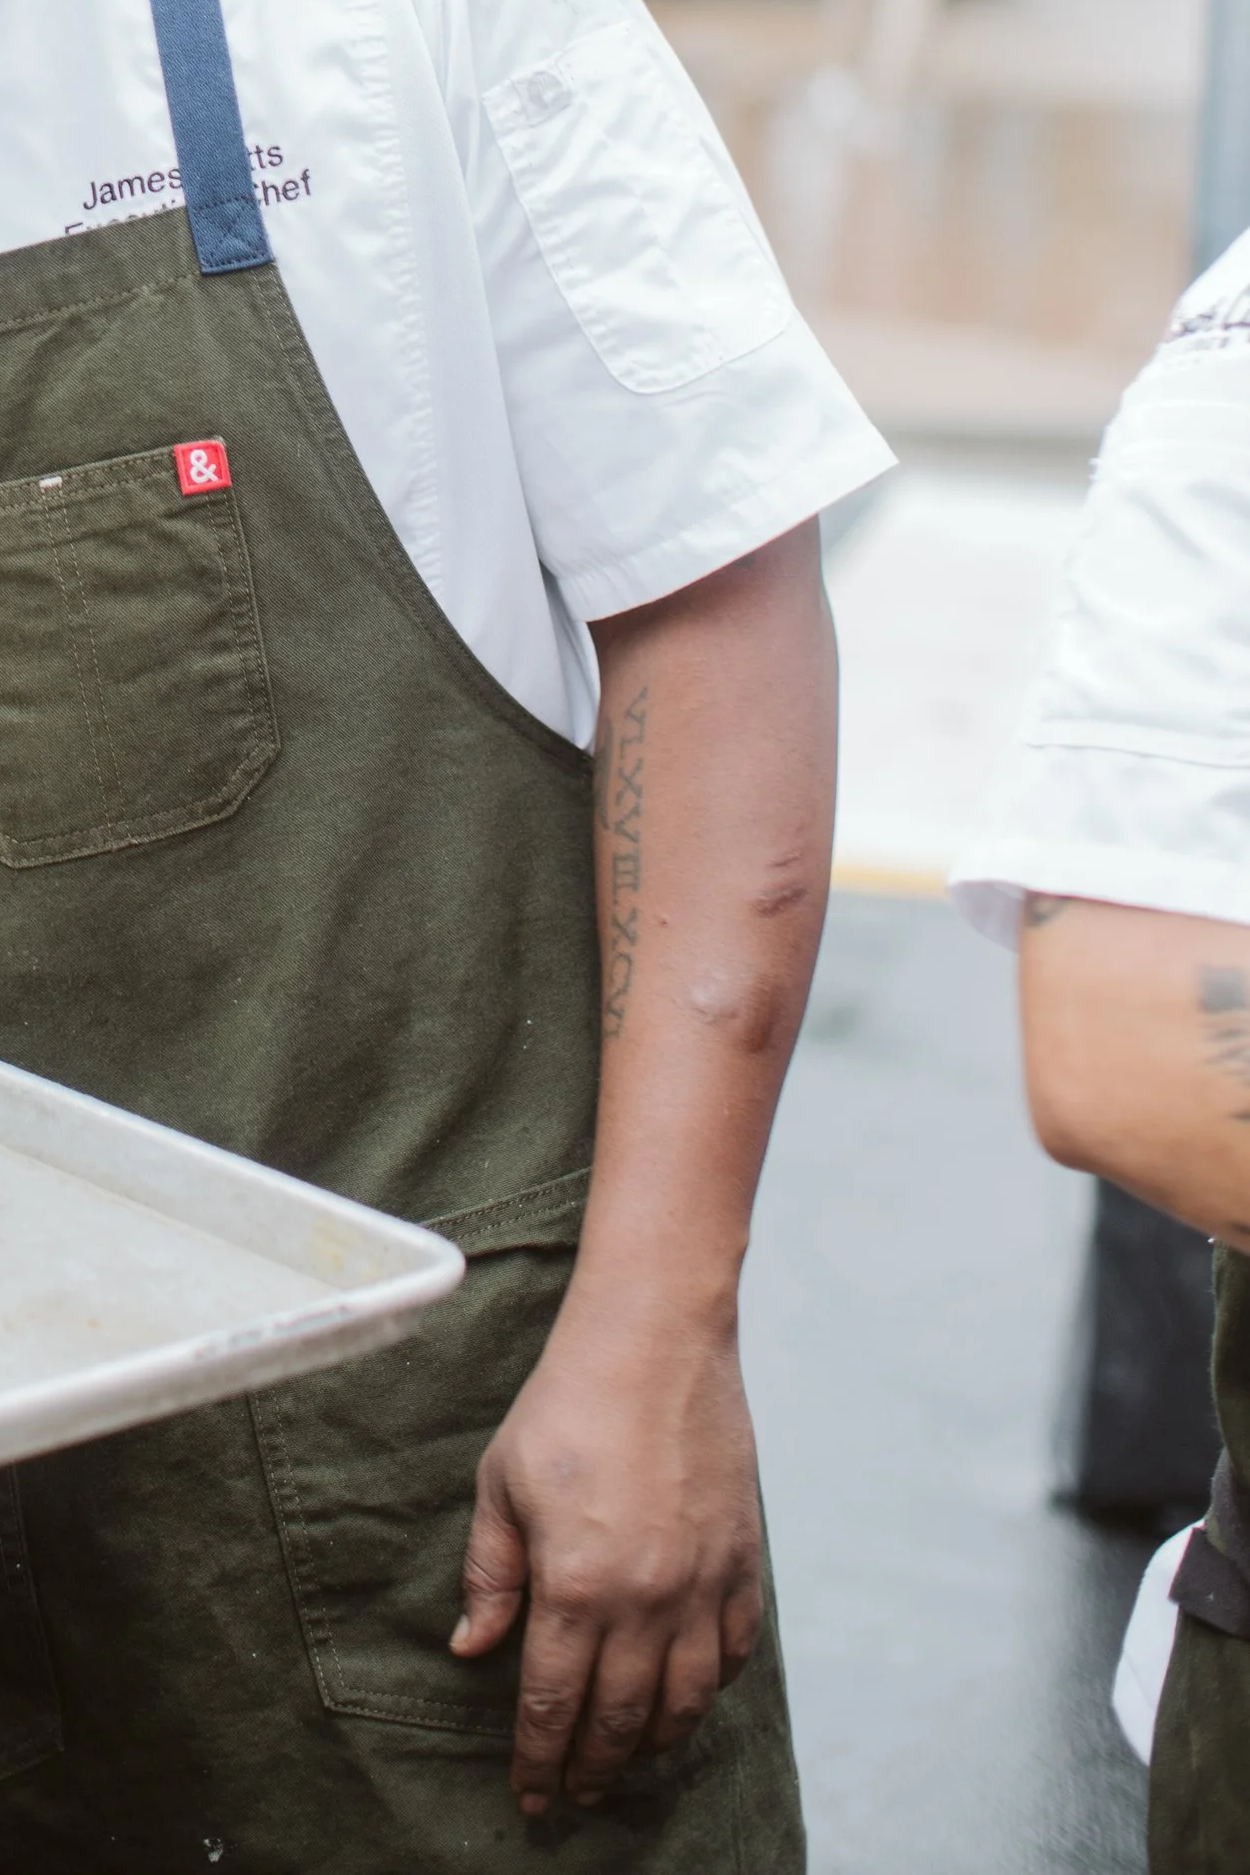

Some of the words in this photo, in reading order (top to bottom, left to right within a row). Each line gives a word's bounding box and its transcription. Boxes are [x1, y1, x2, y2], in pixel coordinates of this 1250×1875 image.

[83, 168, 183, 210] James
[254, 169, 311, 206] hef
[189, 448, 219, 484] &
